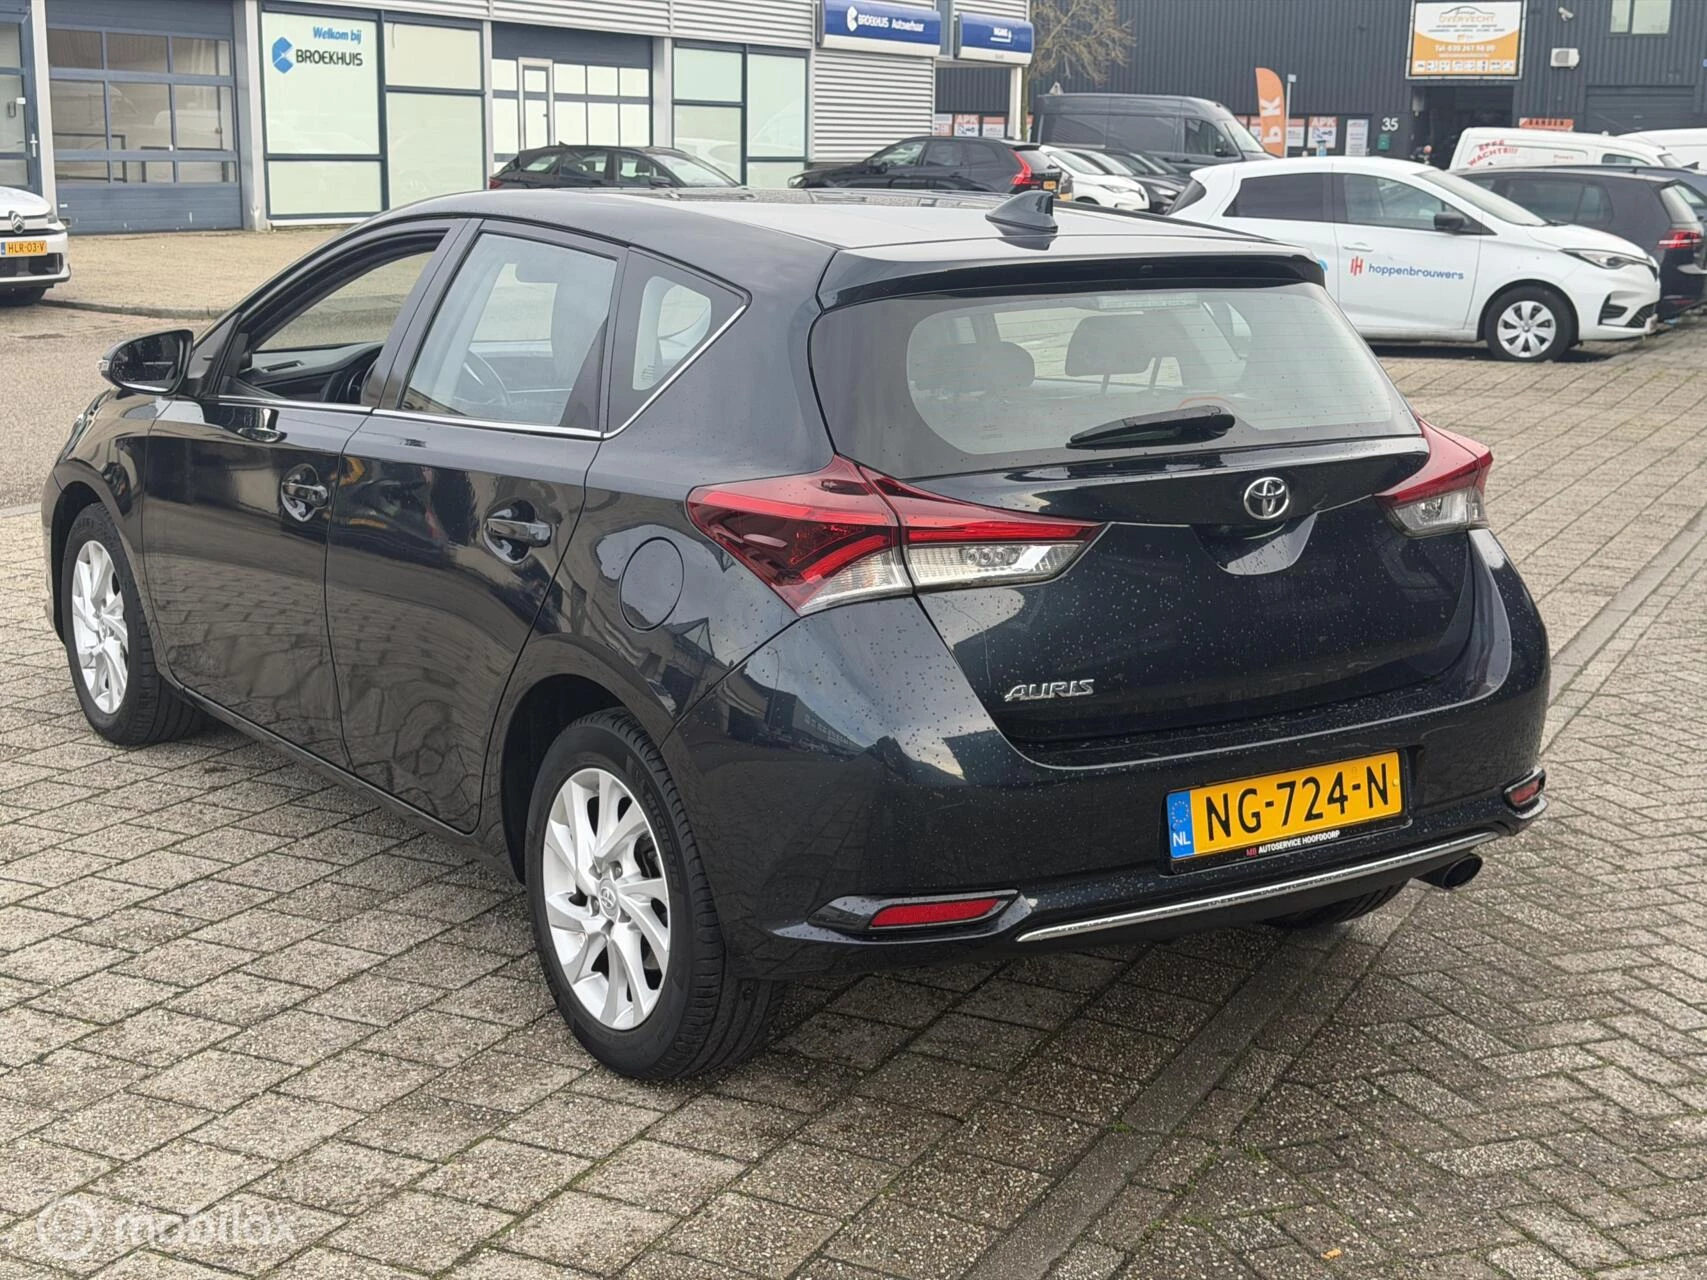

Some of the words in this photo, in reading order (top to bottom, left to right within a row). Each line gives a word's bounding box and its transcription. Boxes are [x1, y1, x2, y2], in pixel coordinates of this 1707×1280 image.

[313, 26, 349, 41] Welkom
[350, 29, 362, 45] bij
[295, 48, 363, 67] BROEKHUIS
[1311, 116, 1336, 127] APK
[1381, 117, 1399, 131] 35
[1368, 263, 1464, 280] hoppenbrouwers
[1004, 679, 1095, 702] AURIS
[1205, 763, 1389, 841] NG-724-N
[1172, 831, 1191, 847] NL
[1258, 837, 1302, 854] AUTOSERVICE
[1302, 829, 1341, 845] HOOFDDORP
